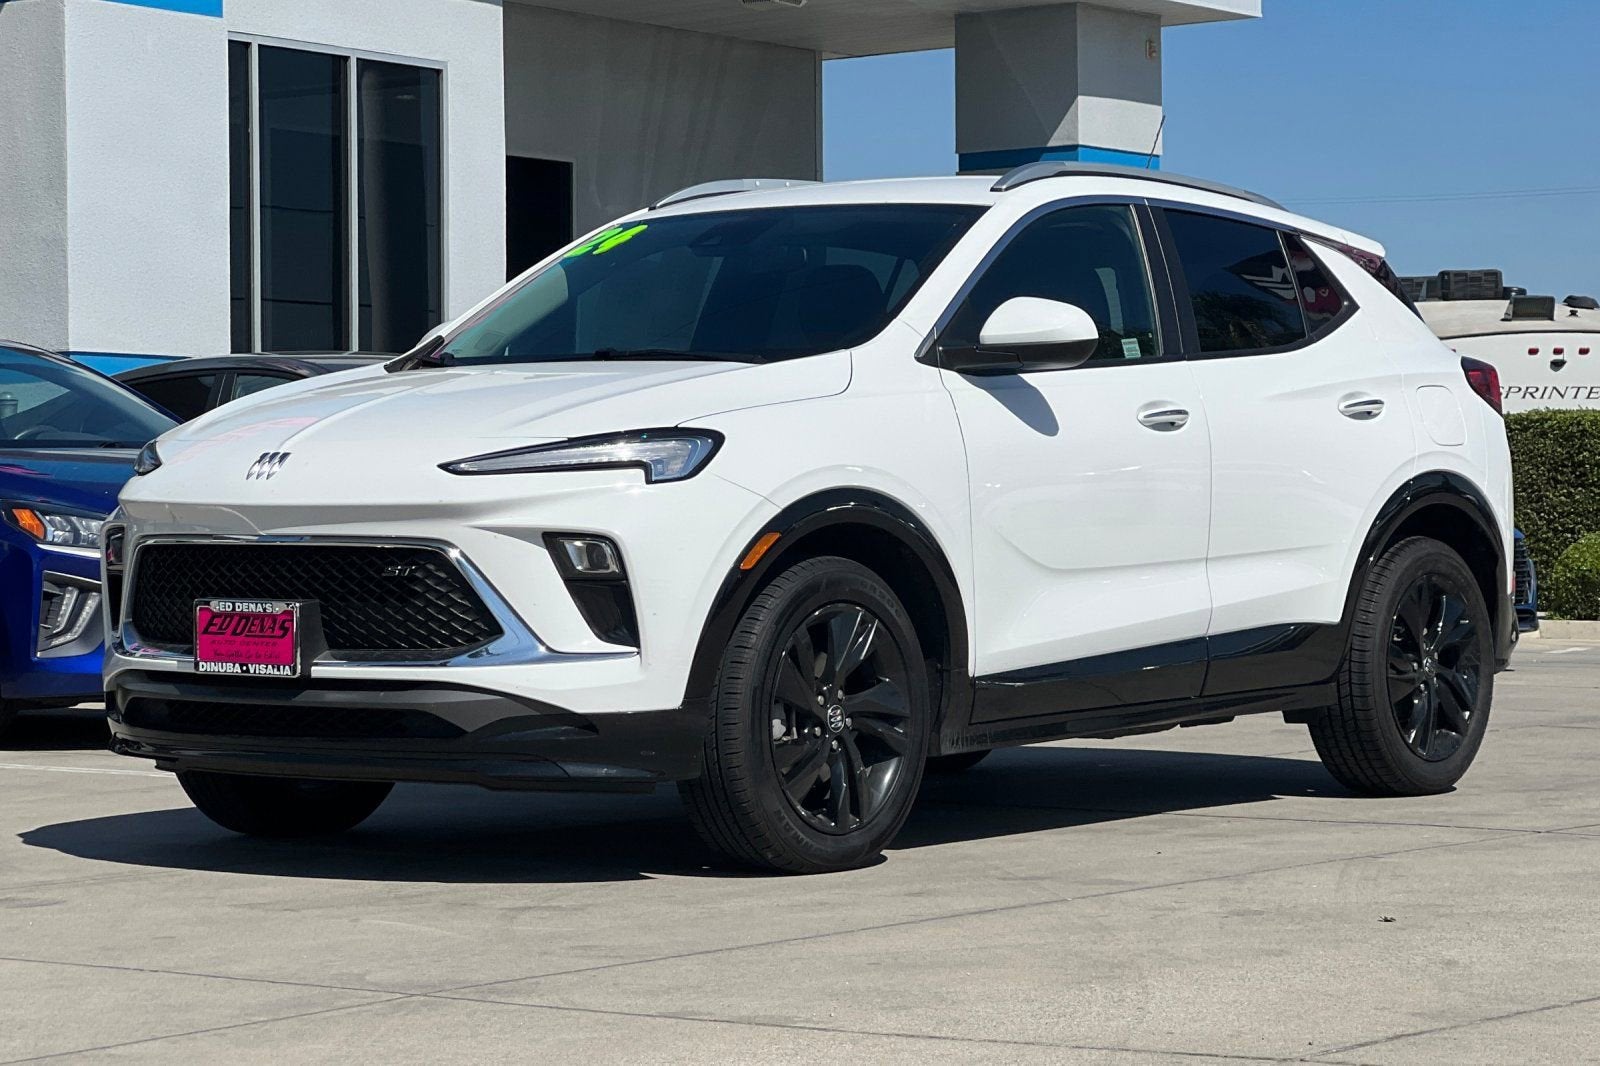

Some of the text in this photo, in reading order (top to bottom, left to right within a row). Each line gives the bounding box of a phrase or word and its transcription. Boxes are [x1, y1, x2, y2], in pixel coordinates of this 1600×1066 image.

[219, 602, 273, 613] ED DENA'S
[199, 661, 292, 676] DINUBA VISALIA
